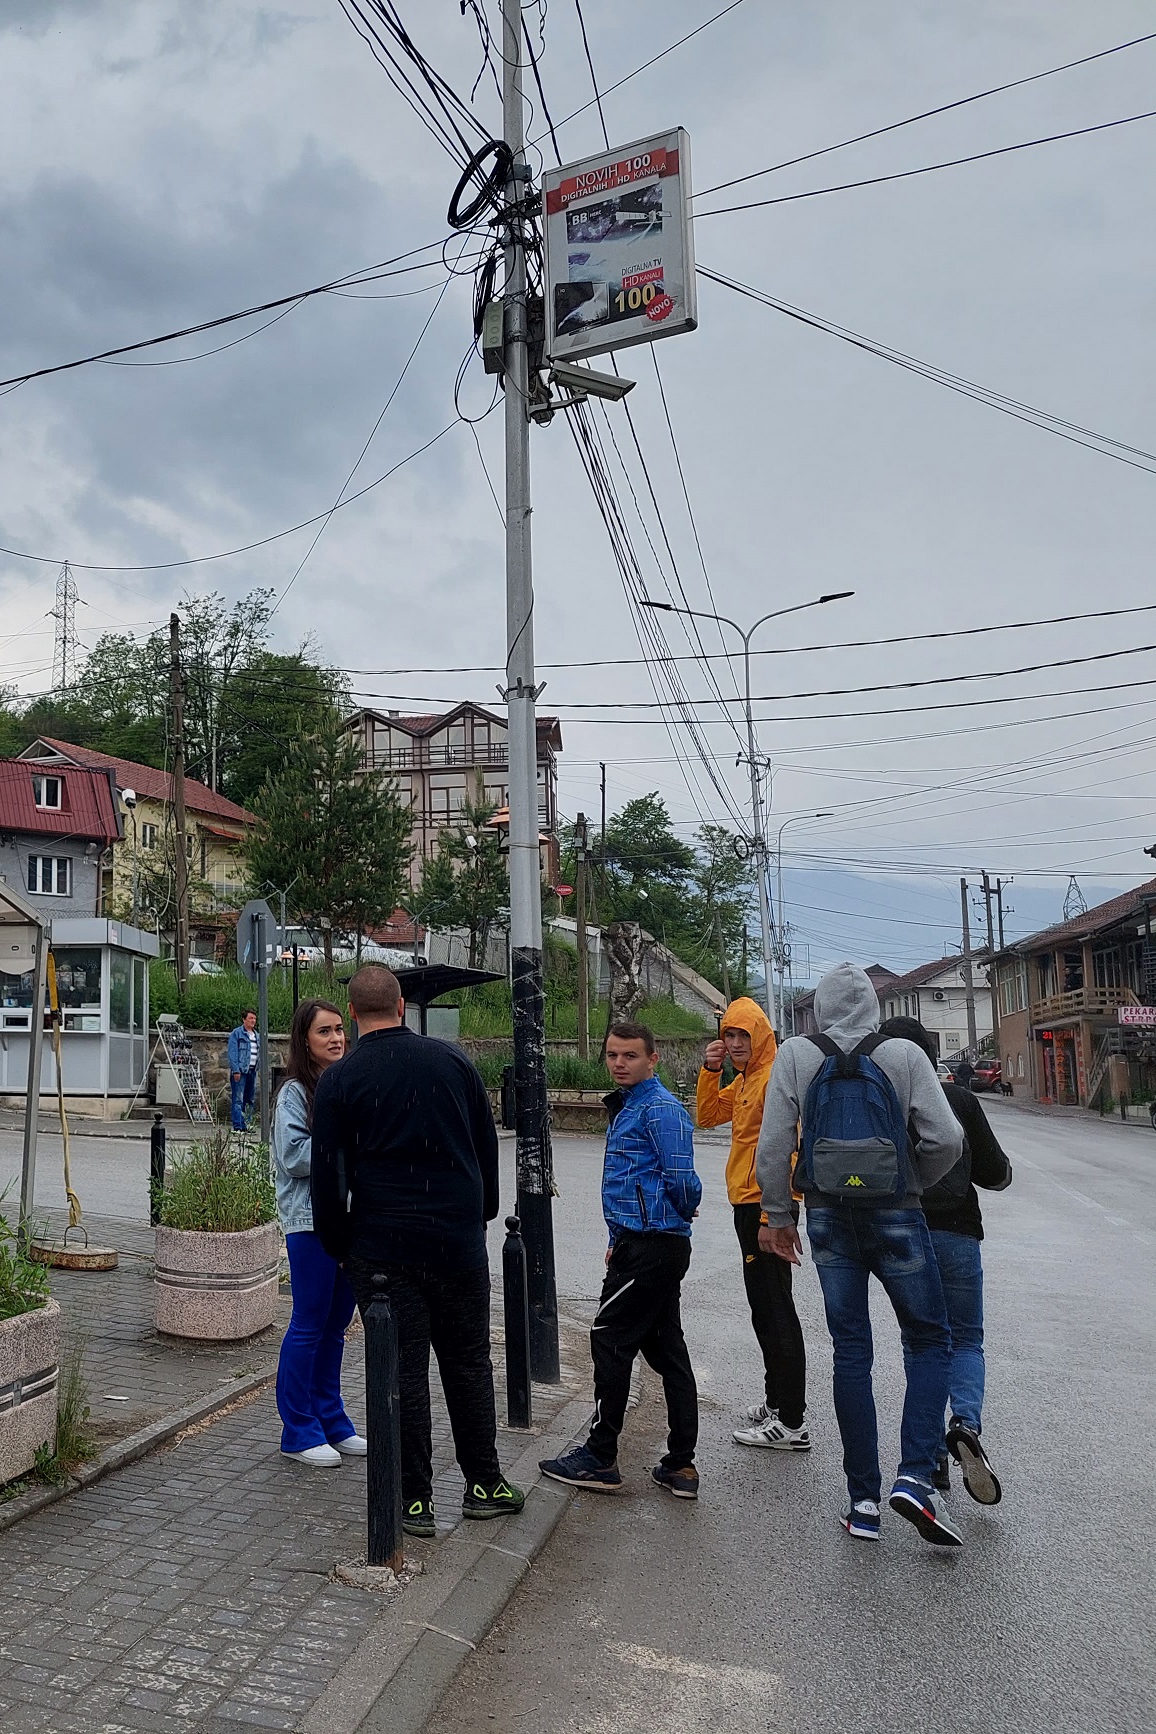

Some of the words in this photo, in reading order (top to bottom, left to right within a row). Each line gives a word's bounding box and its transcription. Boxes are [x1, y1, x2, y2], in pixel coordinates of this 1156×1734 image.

[575, 164, 618, 190] NOVIH
[625, 154, 651, 173] 100
[561, 183, 608, 203] DIGITALNIH
[617, 174, 630, 185] HD
[633, 162, 666, 179] KANALA
[572, 212, 588, 226] BB
[621, 260, 652, 276] DIGITALNA
[653, 257, 662, 267] TV
[624, 275, 639, 288] HD
[639, 270, 661, 282] KANALI
[614, 283, 656, 313] 100
[648, 298, 671, 318] NOVO
[1123, 1007, 1156, 1016] PEKAR
